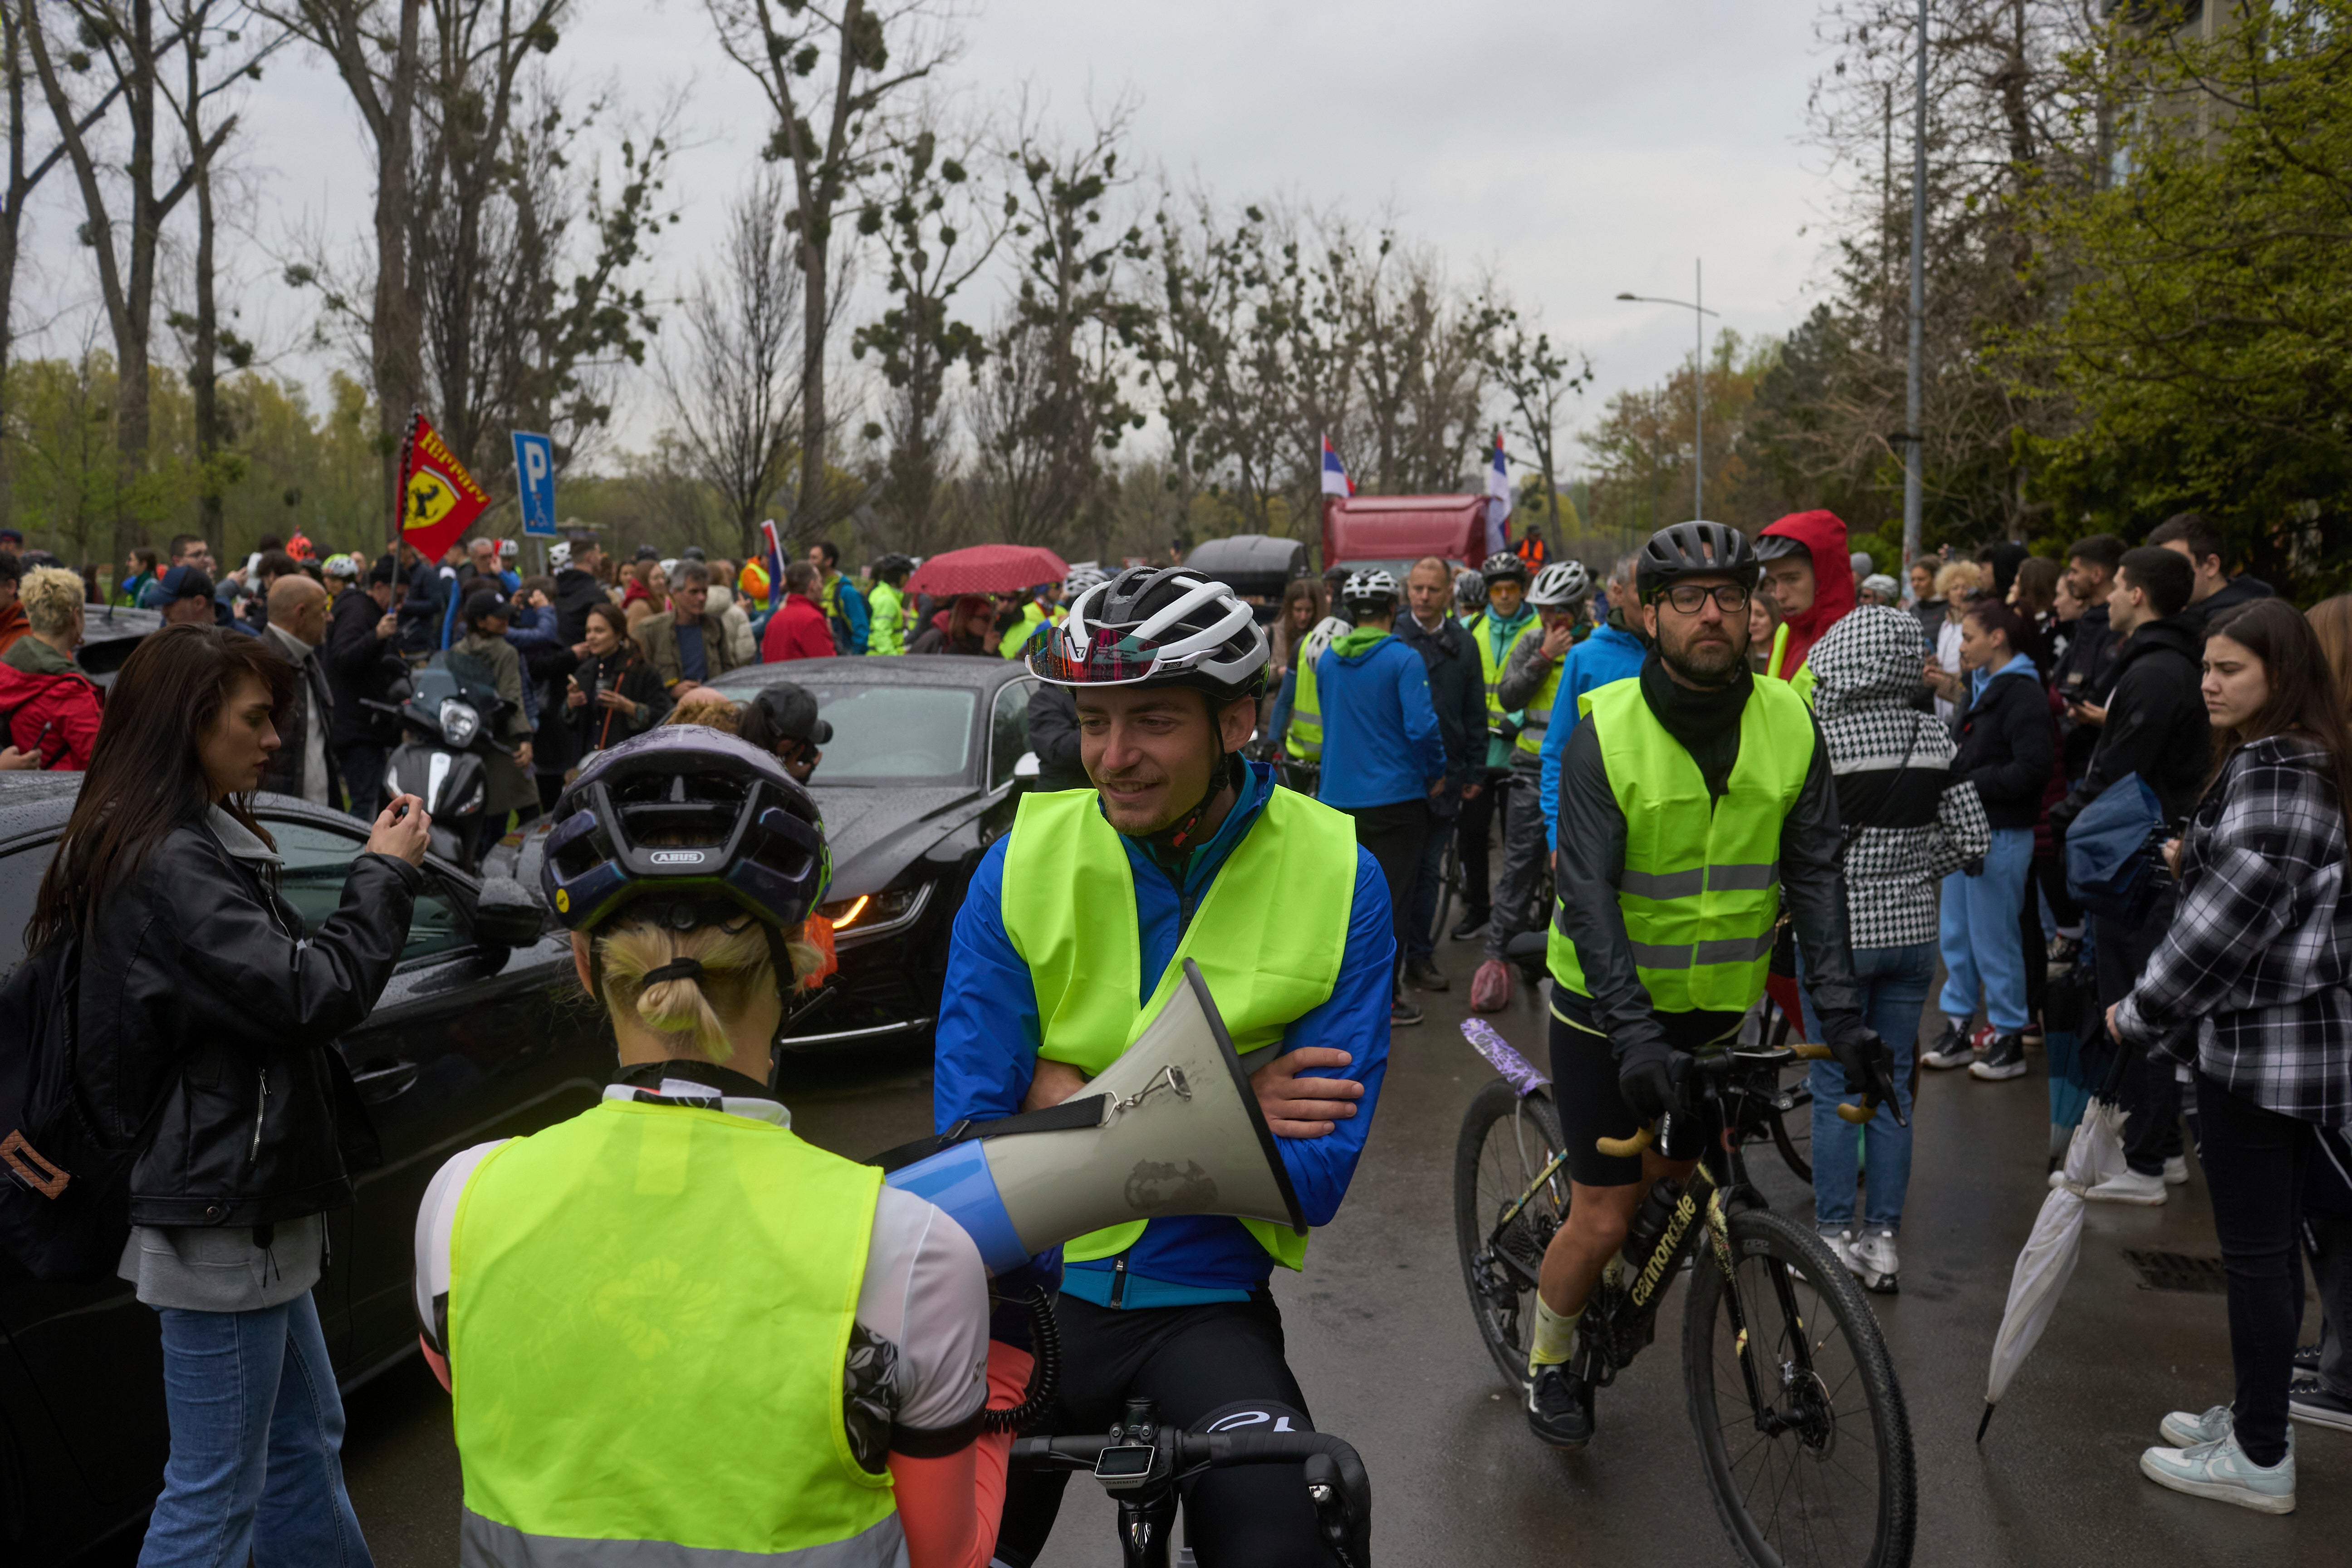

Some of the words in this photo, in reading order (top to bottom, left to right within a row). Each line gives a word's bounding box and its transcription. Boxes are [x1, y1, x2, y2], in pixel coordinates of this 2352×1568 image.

[524, 441, 548, 493] P
[657, 853, 698, 862] ABUS
[1632, 1195, 1696, 1307] cannondale
